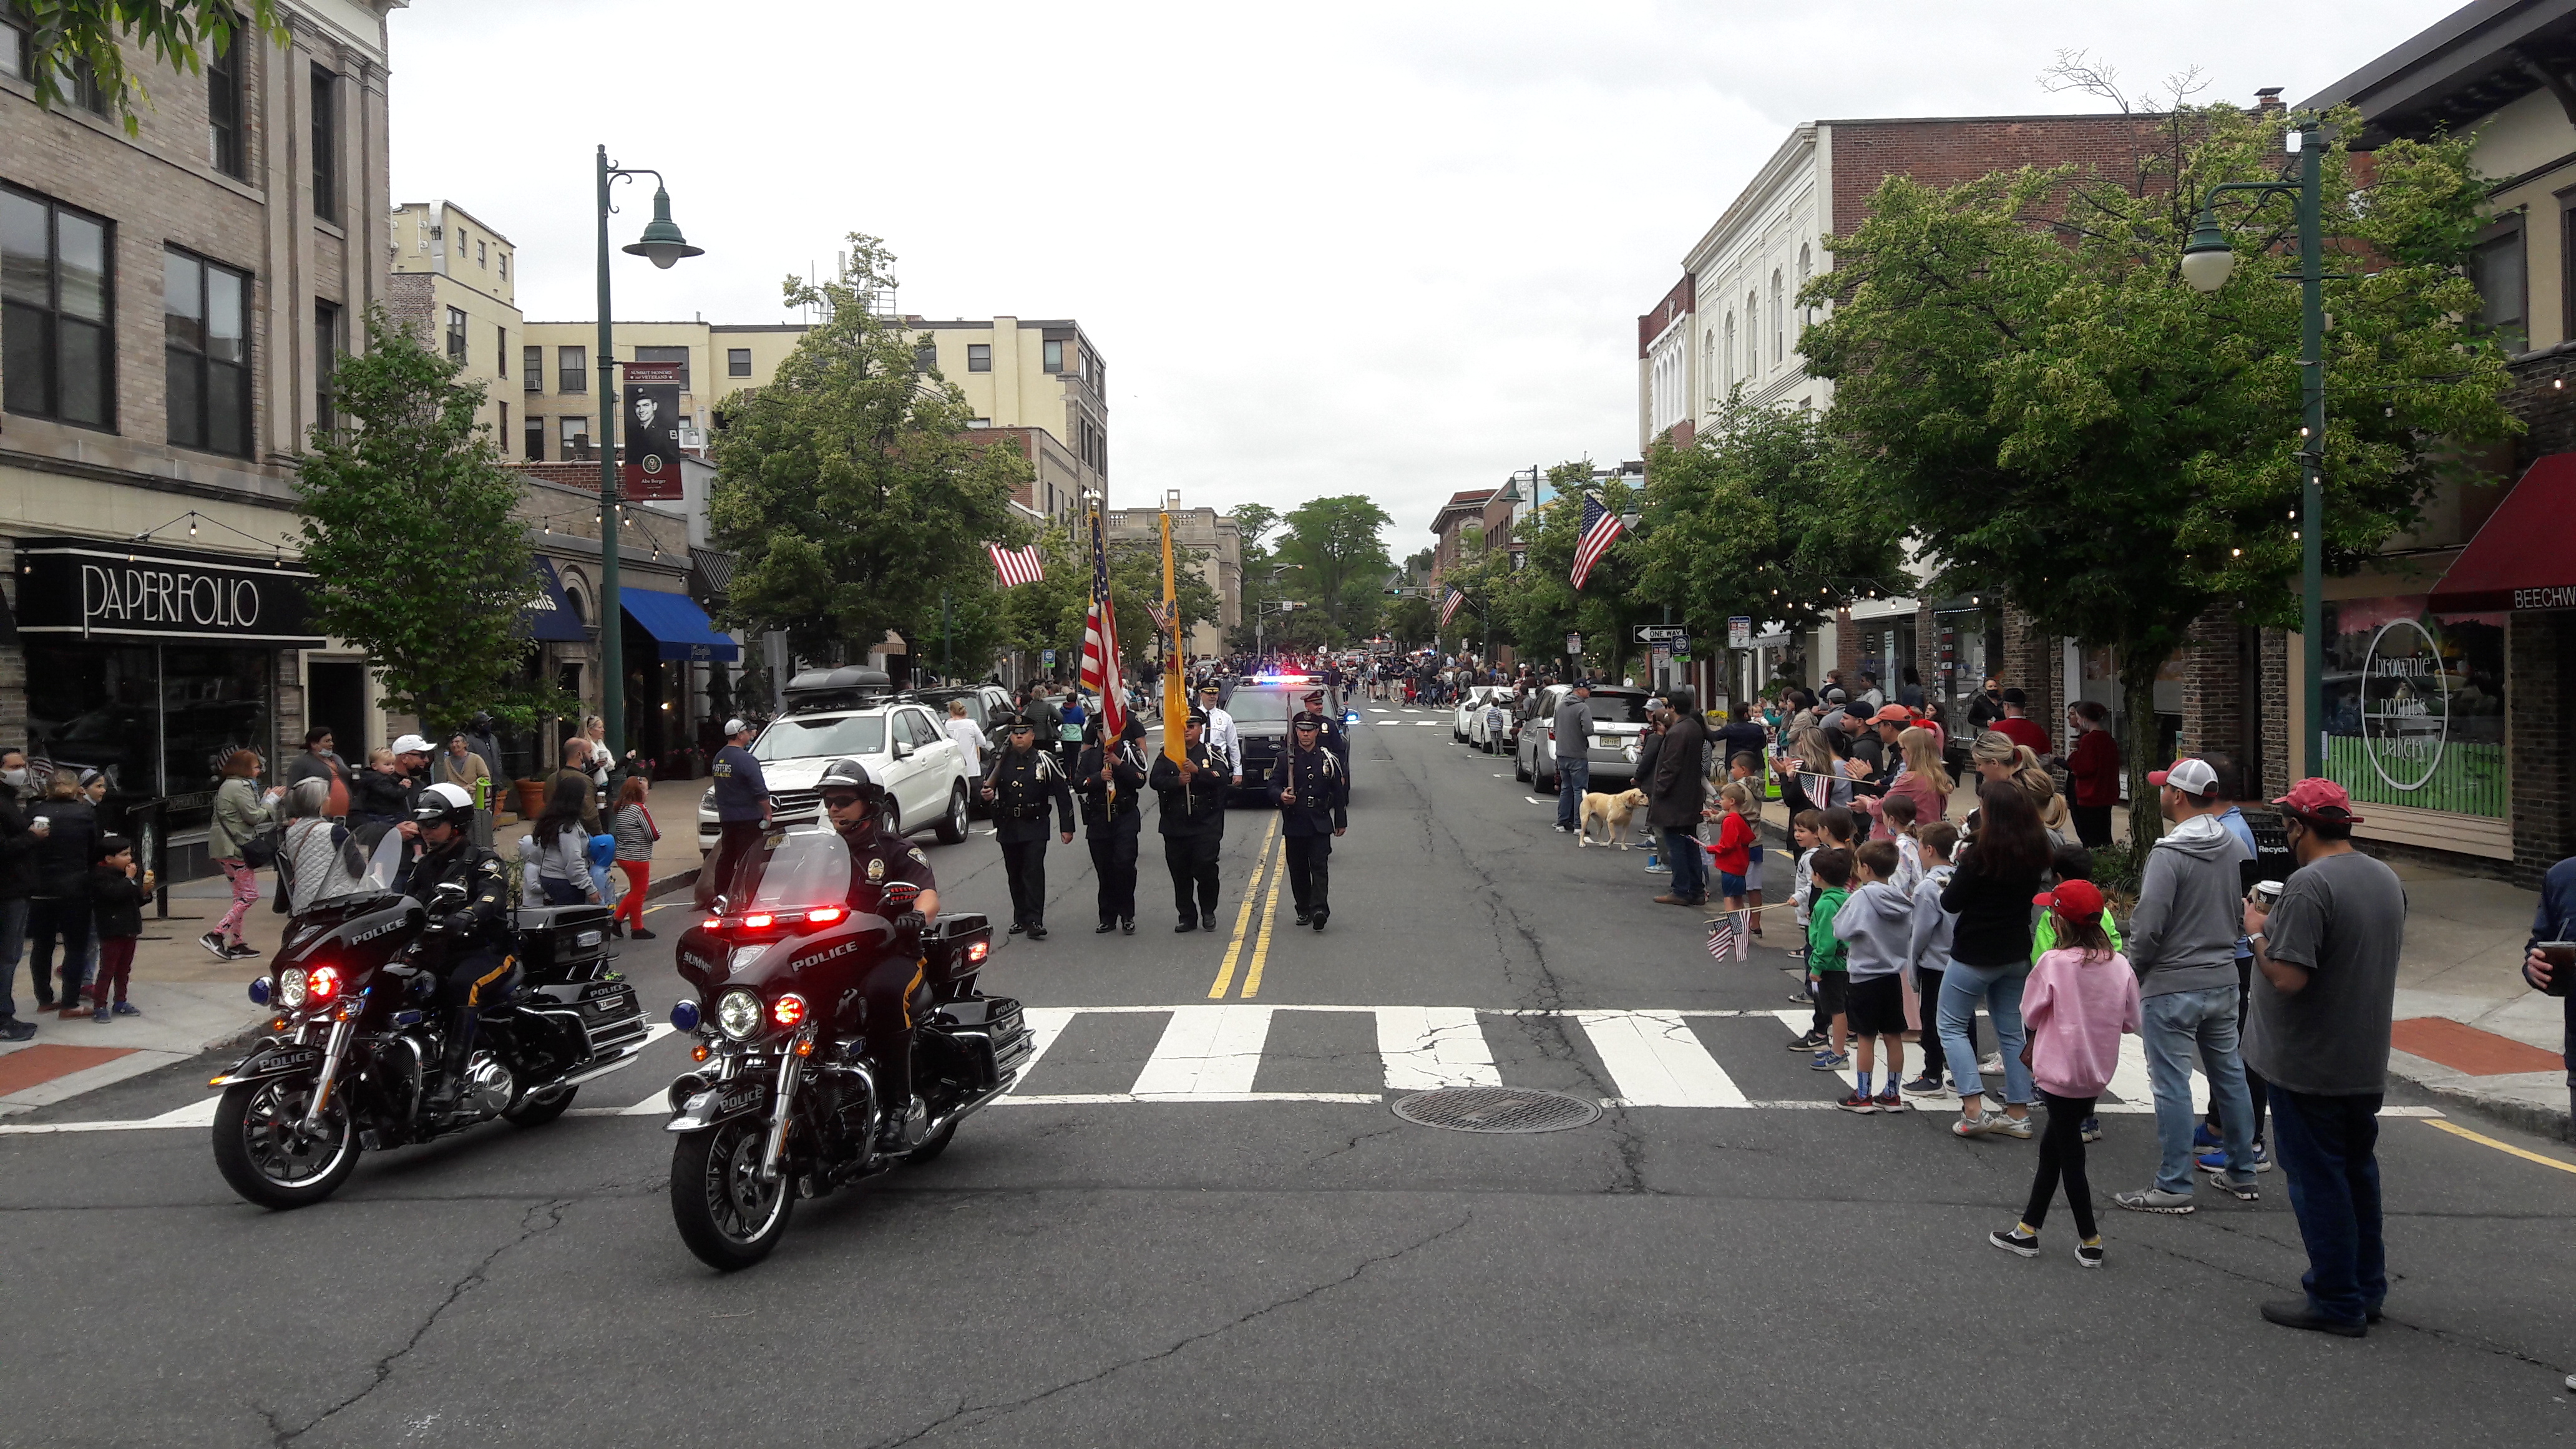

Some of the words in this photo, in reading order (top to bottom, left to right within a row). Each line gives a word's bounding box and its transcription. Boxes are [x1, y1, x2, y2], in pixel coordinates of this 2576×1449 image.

[82, 565, 259, 639] PAPERFOLIO
[2514, 586, 2576, 609] BEECHW
[2375, 651, 2431, 678] brownie
[2380, 691, 2427, 725] points
[2380, 728, 2426, 767] bakery
[351, 917, 406, 946] POLICE
[791, 940, 859, 972] POLICE
[590, 983, 625, 998] POLICE
[258, 1051, 314, 1070] POLICE
[720, 1088, 763, 1111] POLICE
